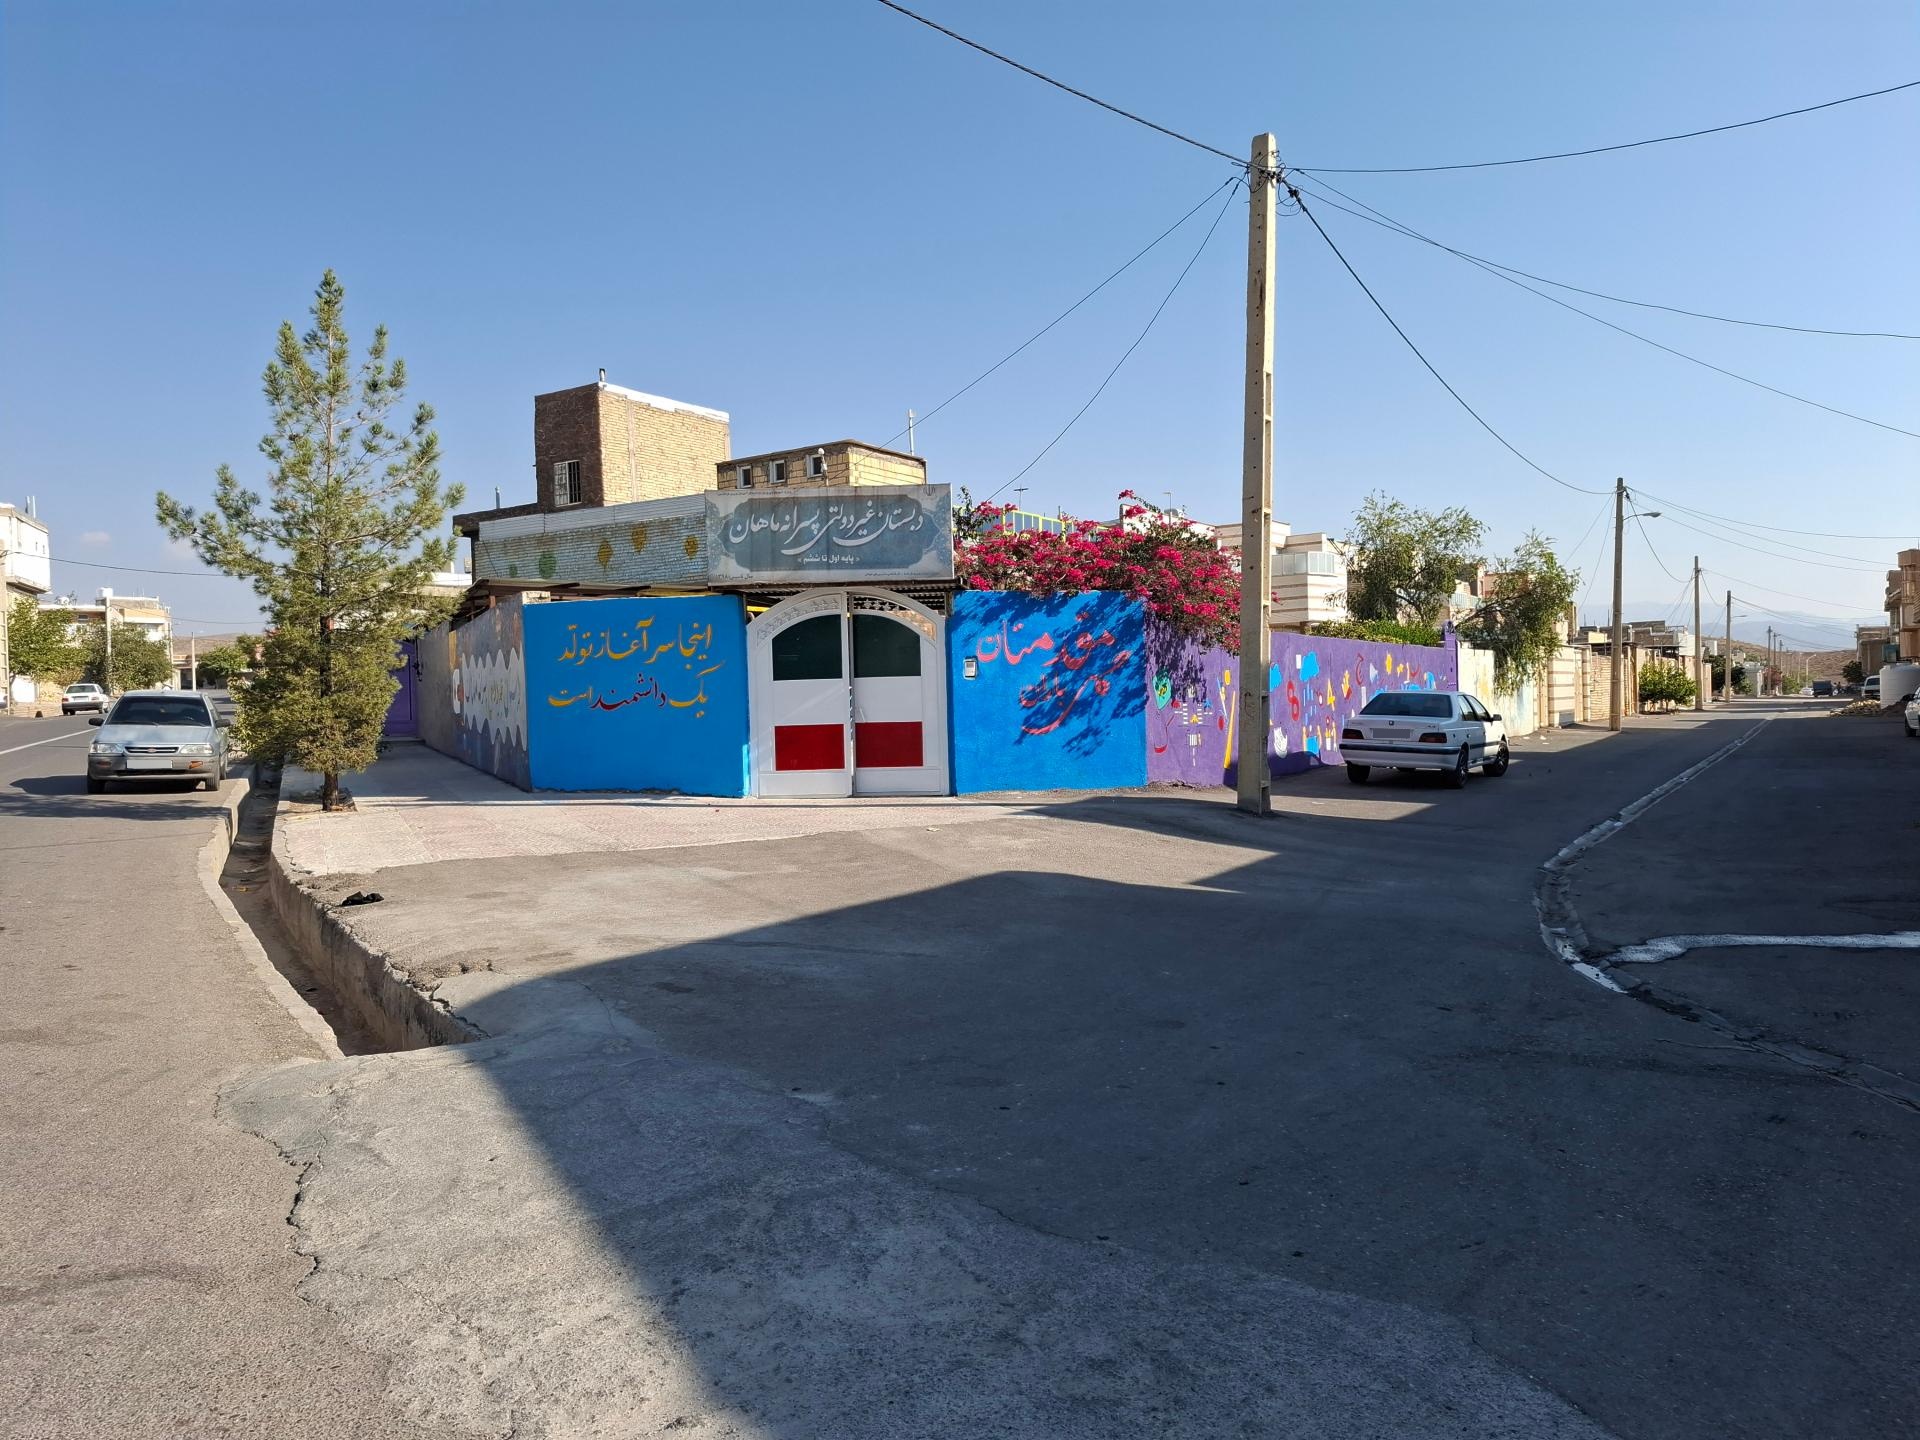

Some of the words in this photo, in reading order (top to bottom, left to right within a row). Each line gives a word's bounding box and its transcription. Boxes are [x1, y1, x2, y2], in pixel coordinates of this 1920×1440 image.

[728, 512, 780, 544] ماهان
[779, 505, 821, 545] پسرانه
[832, 507, 925, 546] دبستان
[803, 553, 820, 564] ششم
[821, 554, 828, 562] تا
[829, 554, 840, 564] اول
[841, 554, 854, 564] پایه
[678, 622, 713, 669] اینجا
[547, 686, 593, 707] است
[591, 671, 667, 711] دانشمند
[668, 660, 725, 718] یک
